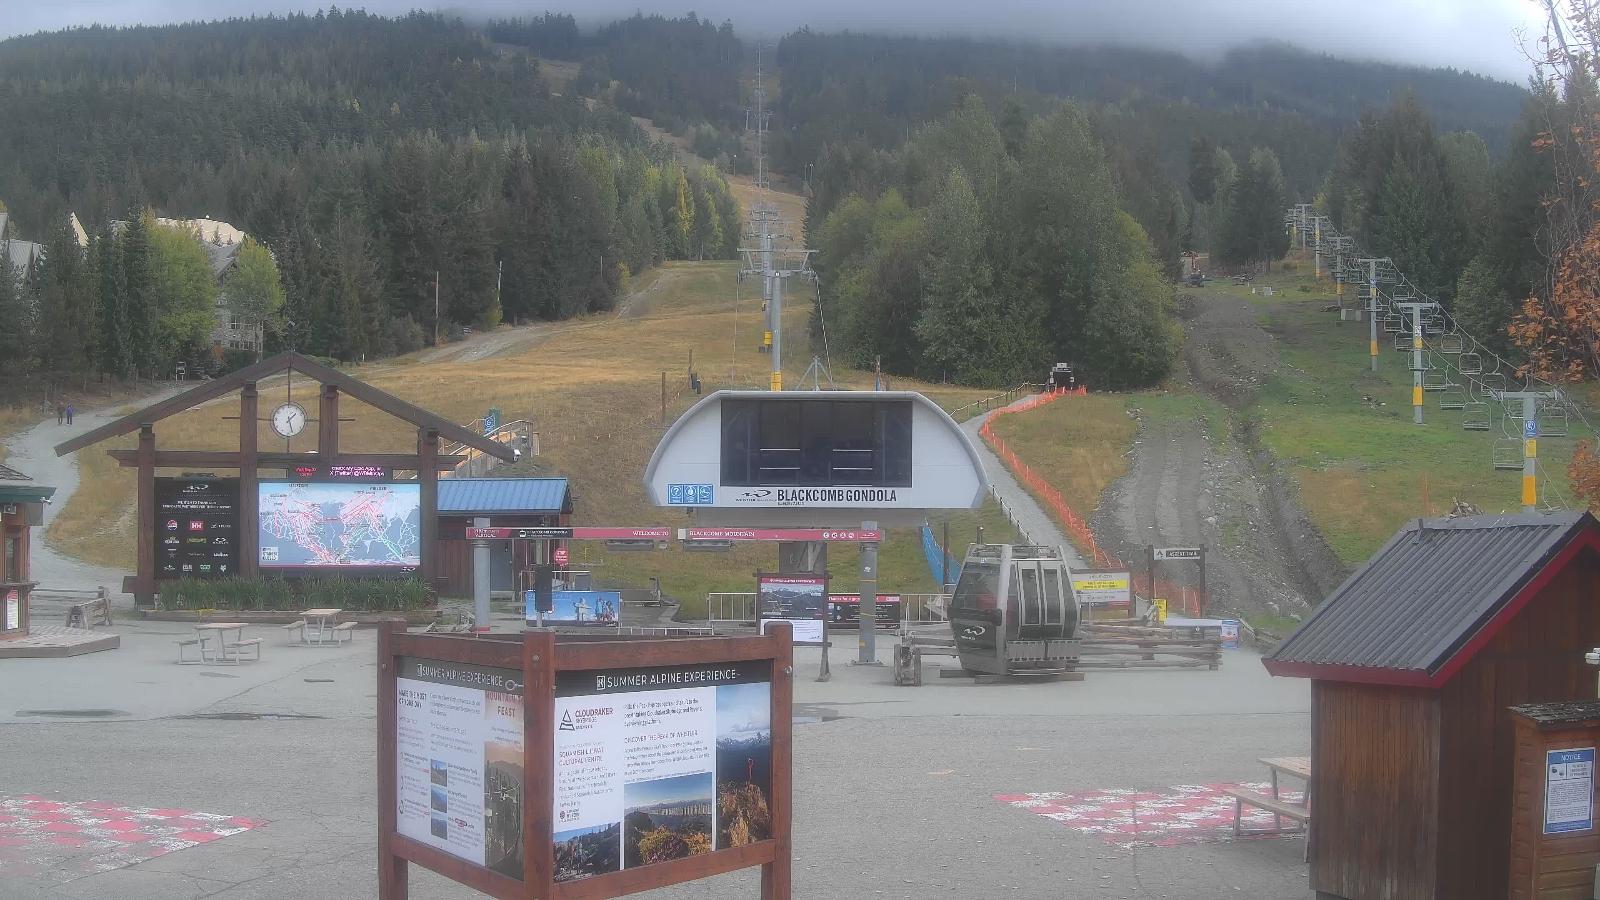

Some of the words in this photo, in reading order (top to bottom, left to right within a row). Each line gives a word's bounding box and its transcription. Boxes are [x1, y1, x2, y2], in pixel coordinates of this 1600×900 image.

[777, 489, 844, 502] BLACKCOMB
[846, 489, 897, 502] GONDOLA
[422, 665, 445, 679] SUMMER
[446, 669, 466, 681] ALPINE
[467, 671, 503, 687] EXPERIENCE
[607, 674, 647, 688] SUMMER
[649, 672, 682, 685] ALPINE
[684, 669, 736, 682] EXPERIENCE
[497, 706, 516, 718] FEAST
[575, 707, 614, 718] CLOUDRAKER
[1561, 753, 1581, 762] NOTICE
